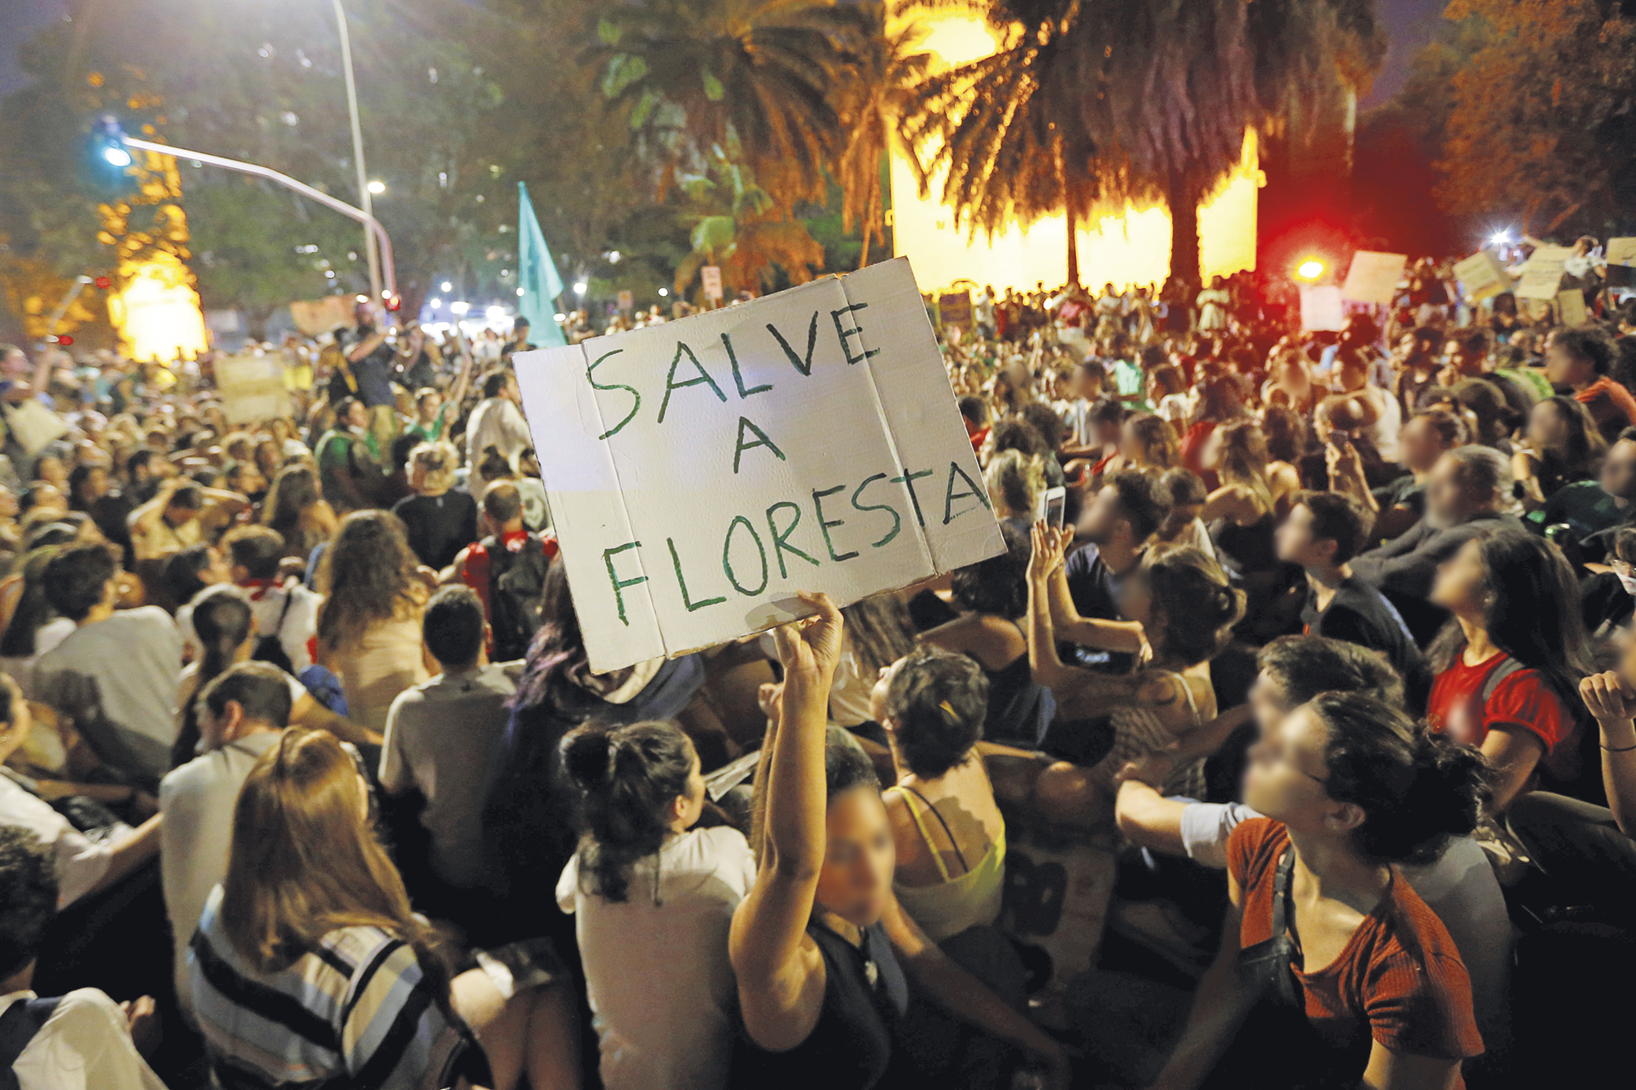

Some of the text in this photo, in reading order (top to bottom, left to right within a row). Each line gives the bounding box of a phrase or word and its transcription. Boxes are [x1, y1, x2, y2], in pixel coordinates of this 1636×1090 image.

[586, 303, 880, 439] SALVE
[734, 416, 785, 473] A
[602, 462, 990, 626] FLORESTA
